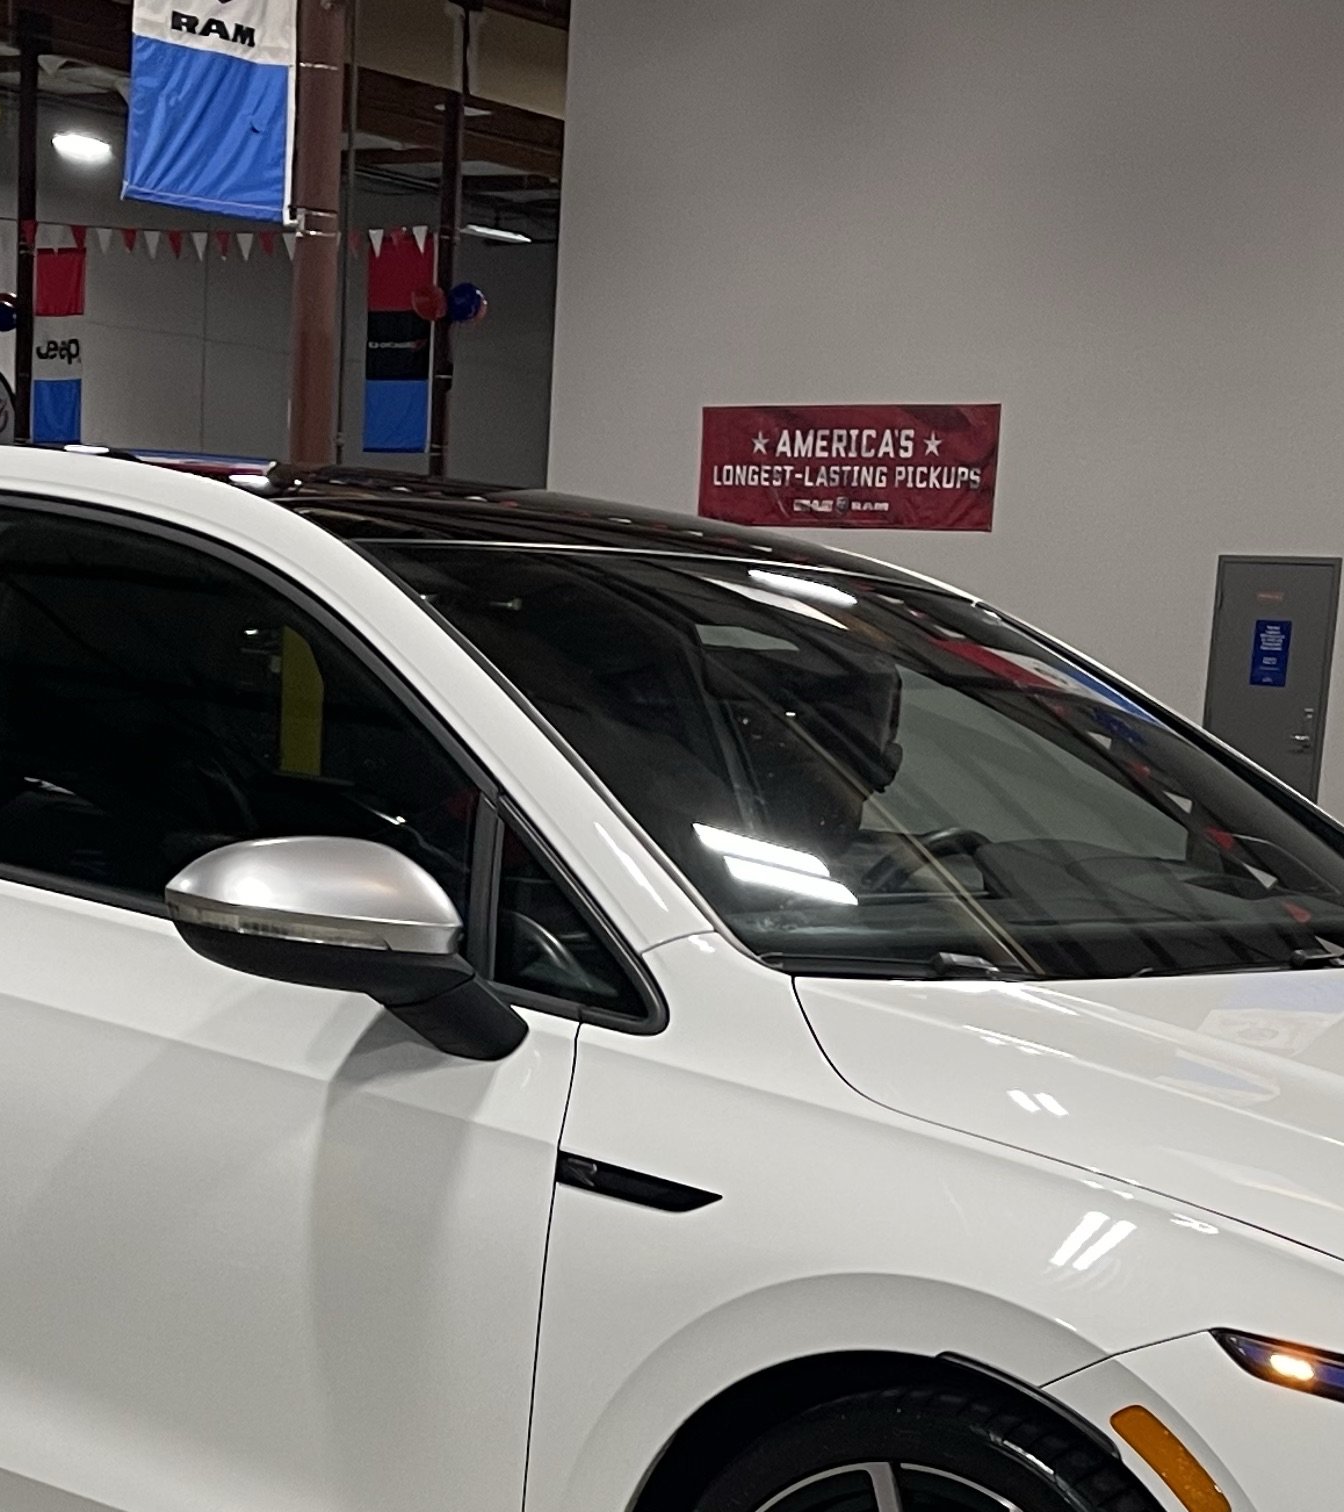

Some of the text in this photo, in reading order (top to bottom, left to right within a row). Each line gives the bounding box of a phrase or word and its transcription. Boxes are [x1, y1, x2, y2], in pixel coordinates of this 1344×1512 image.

[171, 10, 256, 48] RAM
[775, 428, 916, 459] AMERICA'S
[713, 464, 982, 490] LONGEST-LASTING PICKUPS
[851, 501, 890, 512] RAM
